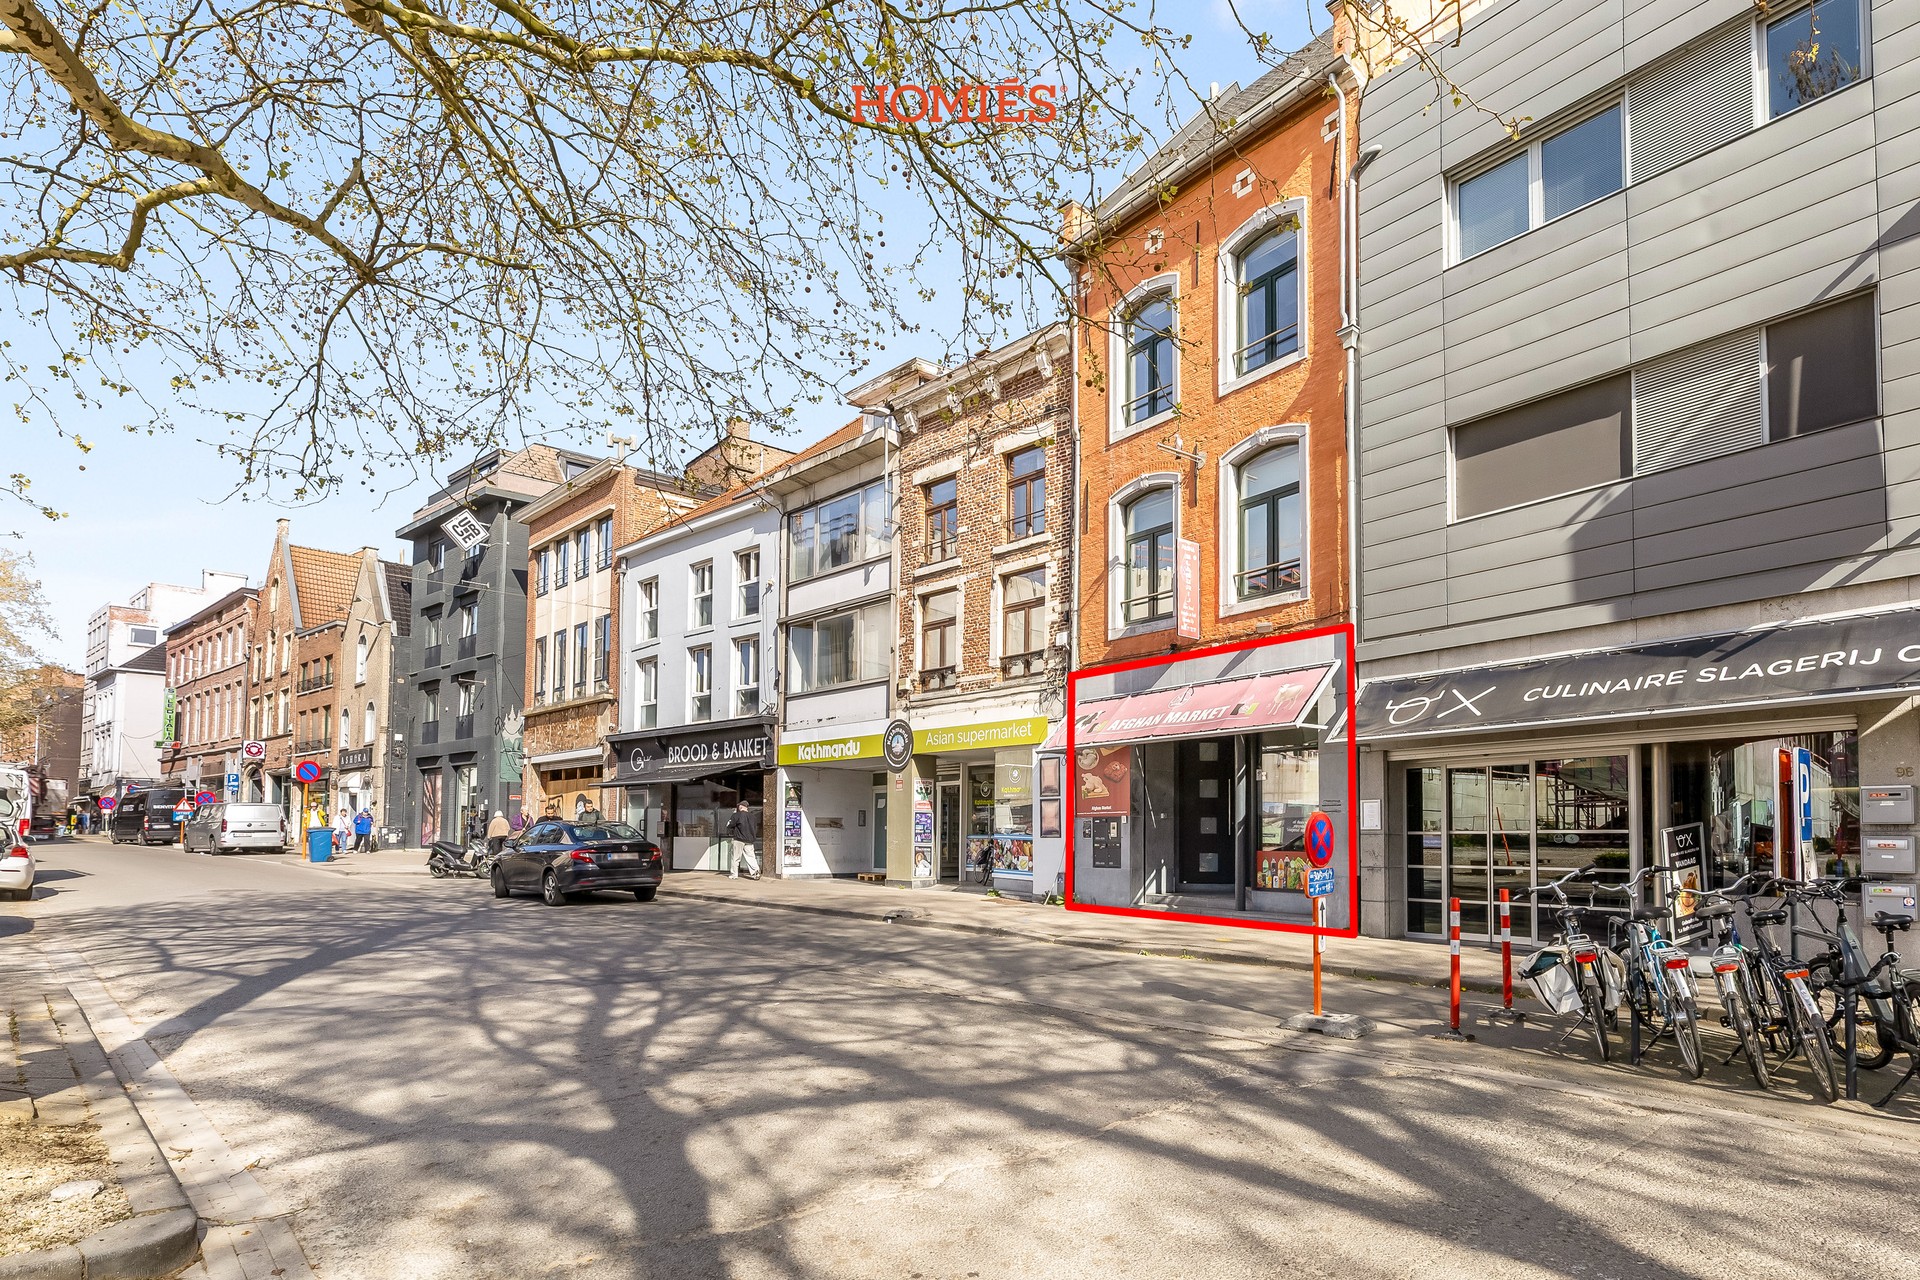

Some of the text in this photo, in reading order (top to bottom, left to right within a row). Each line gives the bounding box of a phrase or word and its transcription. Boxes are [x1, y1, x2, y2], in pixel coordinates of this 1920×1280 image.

[1523, 669, 1688, 702] CULINAIRE
[1696, 648, 1882, 683] SLAGERIJ
[1107, 705, 1231, 731] AFGHAN MARKET
[926, 721, 1033, 746] Asian supermarket
[340, 752, 367, 765] ASHOKA
[668, 736, 769, 764] BROOD & BANKET
[798, 740, 861, 761] Kathmandu
[229, 774, 237, 783] P
[1895, 766, 1915, 778] 96
